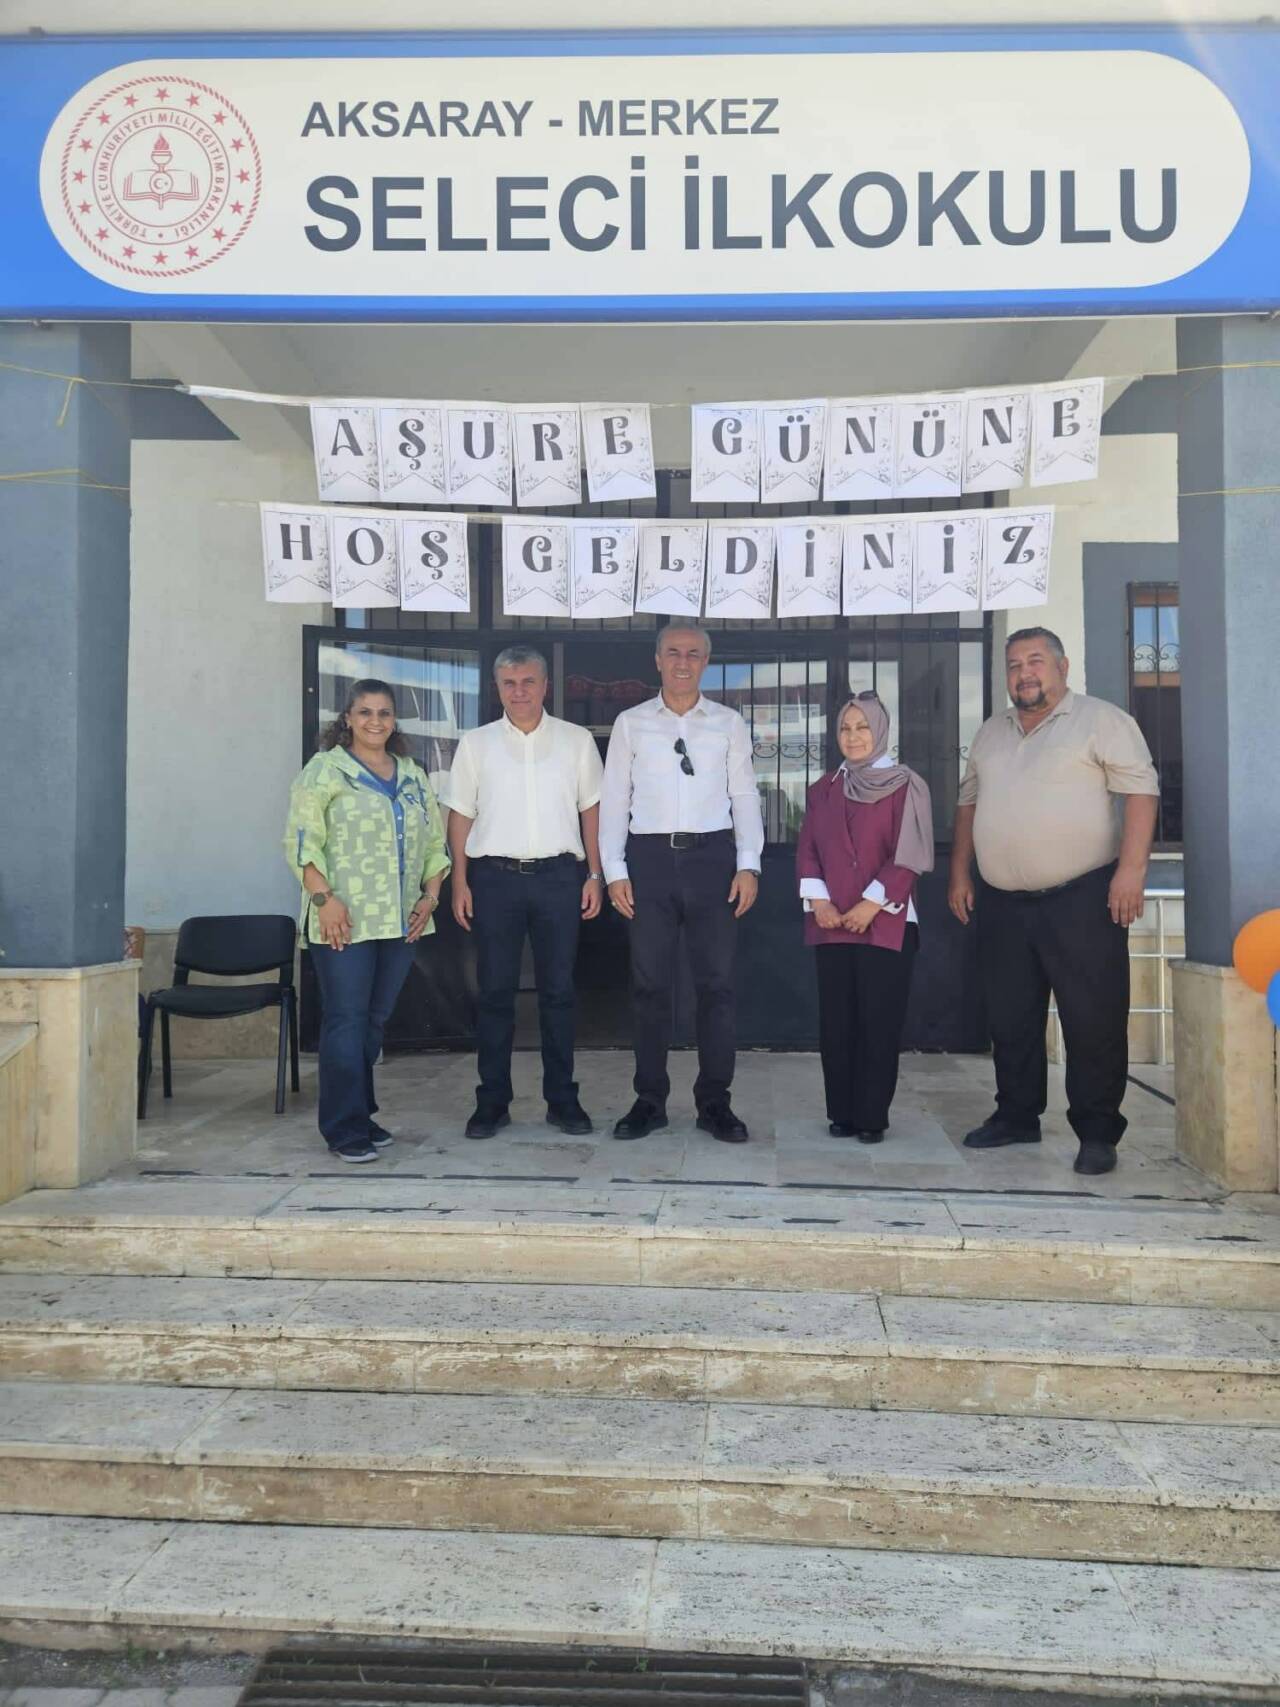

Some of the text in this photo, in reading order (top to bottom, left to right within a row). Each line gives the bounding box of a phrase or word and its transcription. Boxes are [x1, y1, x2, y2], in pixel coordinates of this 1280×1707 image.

[300, 100, 533, 138] AKSARAY
[579, 98, 780, 137] MERKEZ
[98, 111, 225, 238] TÜRKİYE CUMHURİYETİ MİLLİ EĞİTİM BAKANLIĞI
[303, 155, 1177, 252] SELECİ İLKOKULU
[330, 398, 1081, 471] AŞURE GÜNÜNE
[279, 522, 1036, 580] HOŞ GELDİNİZ
